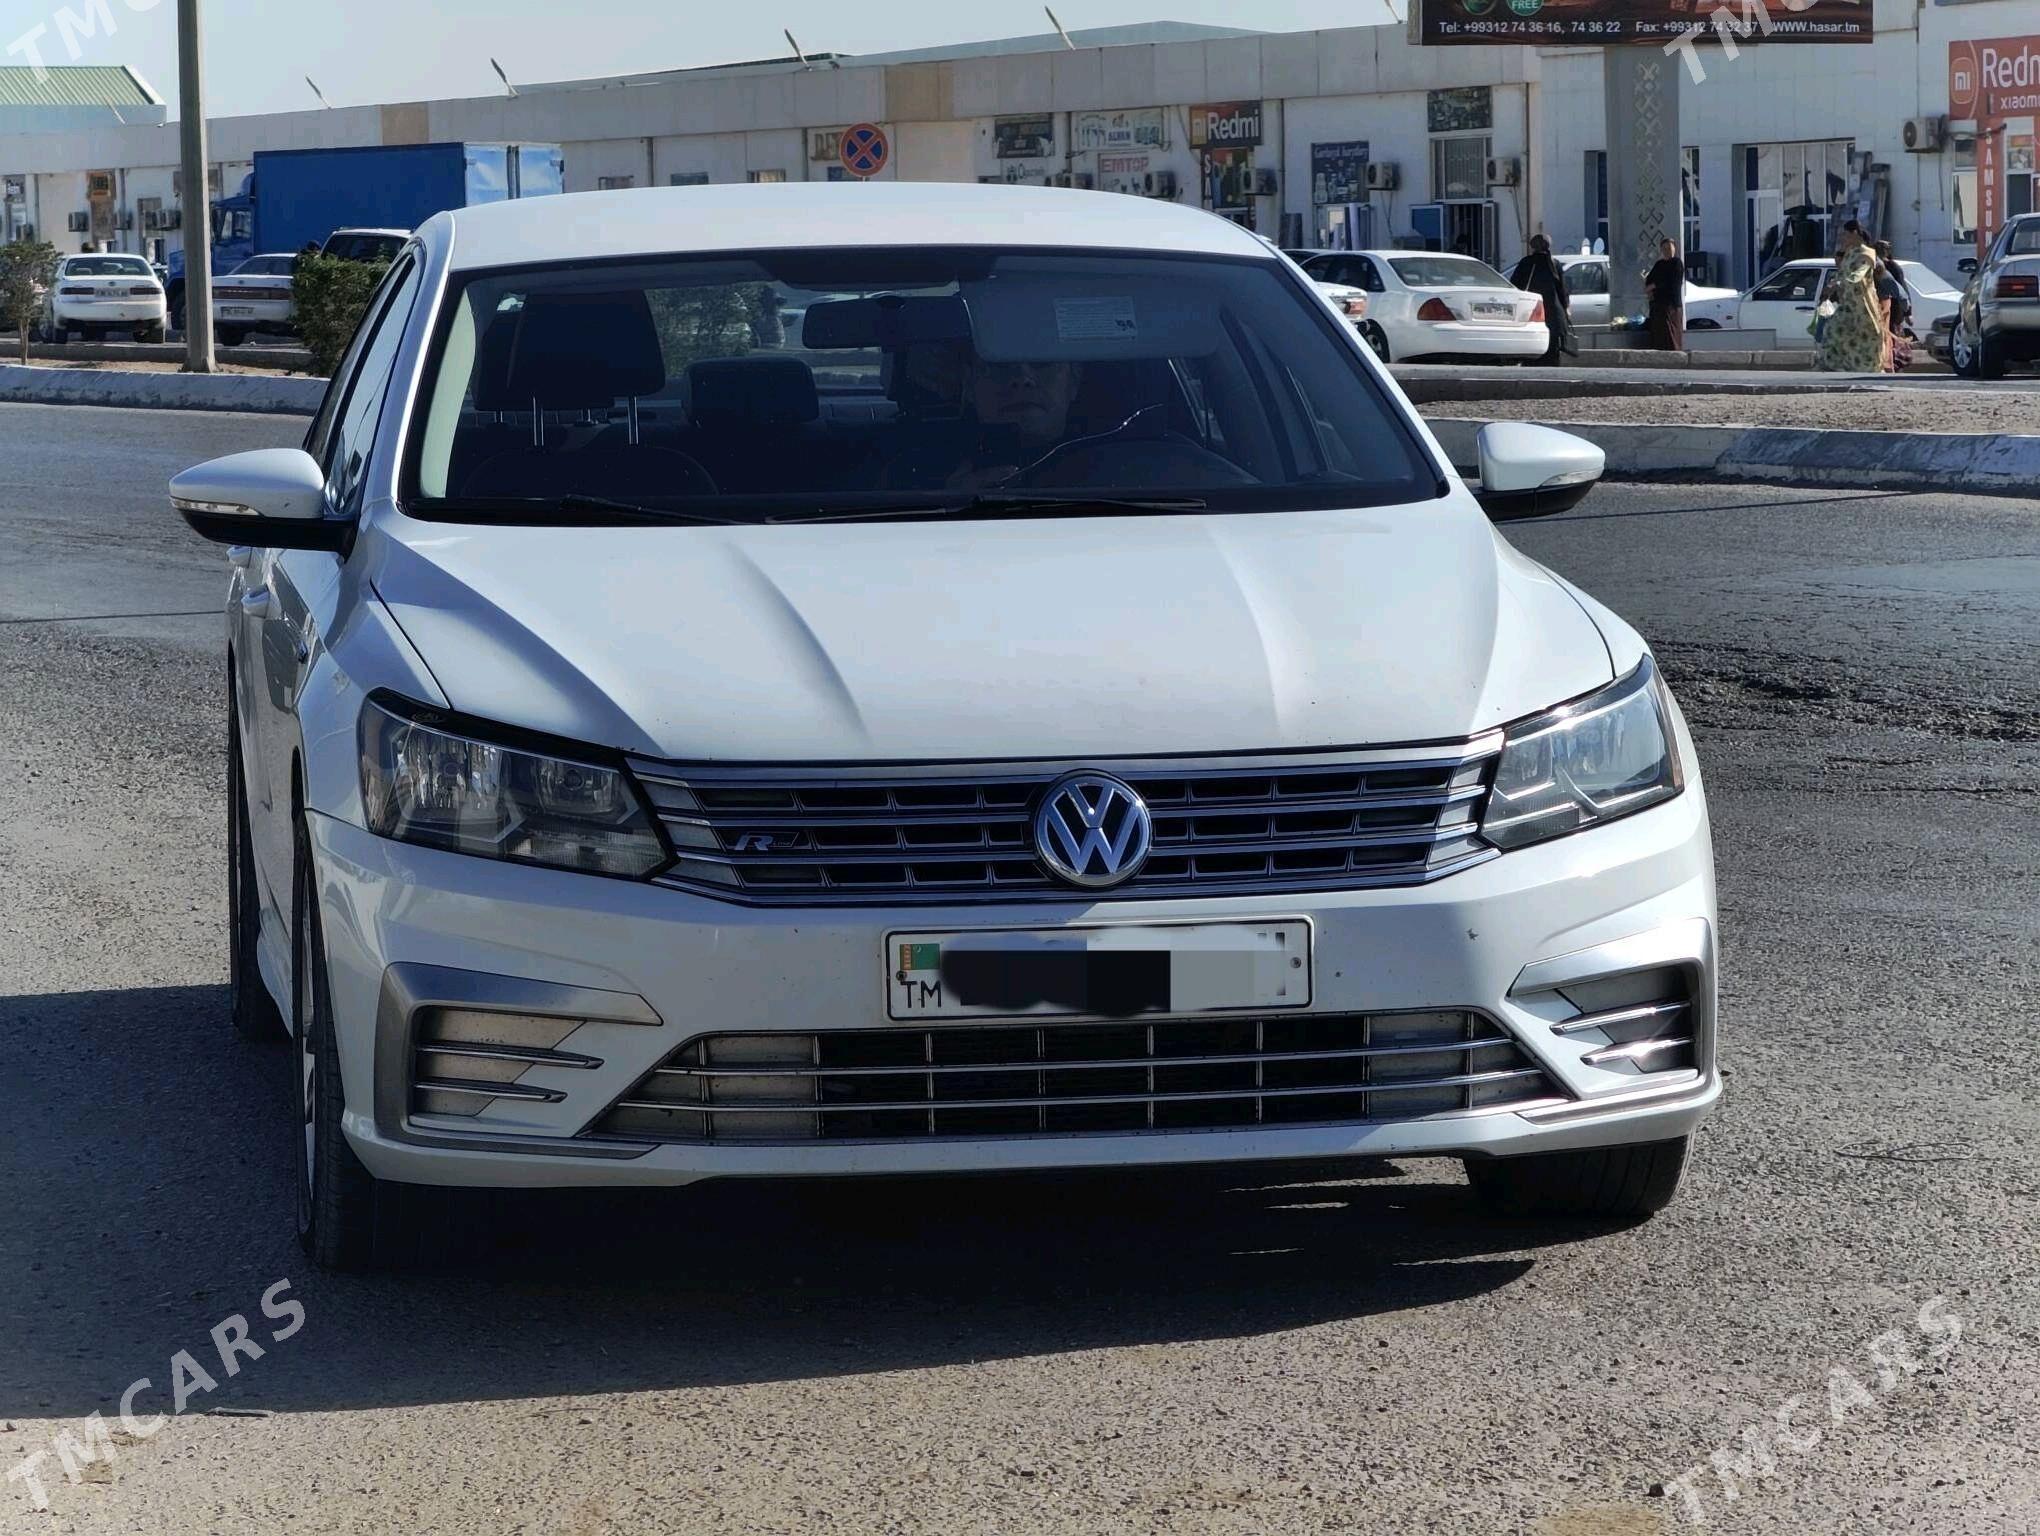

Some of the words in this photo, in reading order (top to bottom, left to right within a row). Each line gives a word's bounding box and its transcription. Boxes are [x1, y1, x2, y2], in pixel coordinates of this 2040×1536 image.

[1439, 21, 1461, 33] Tel:
[1463, 21, 1508, 33] +99312
[1511, 21, 1526, 33] 74
[1528, 21, 1543, 33] 36
[1547, 21, 1565, 34] 16,
[1571, 21, 1586, 33] 74
[1588, 21, 1604, 33] 36
[1605, 21, 1621, 33] 22
[1635, 21, 1659, 33] Fax:
[1663, 21, 1706, 33] +99312
[1709, 21, 1723, 33] 74
[1727, 21, 1742, 33] 32
[1744, 21, 1758, 33] 37
[1207, 109, 1260, 141] Redmi
[1101, 157, 1150, 173] EMTOP
[900, 980, 942, 1009] TM
